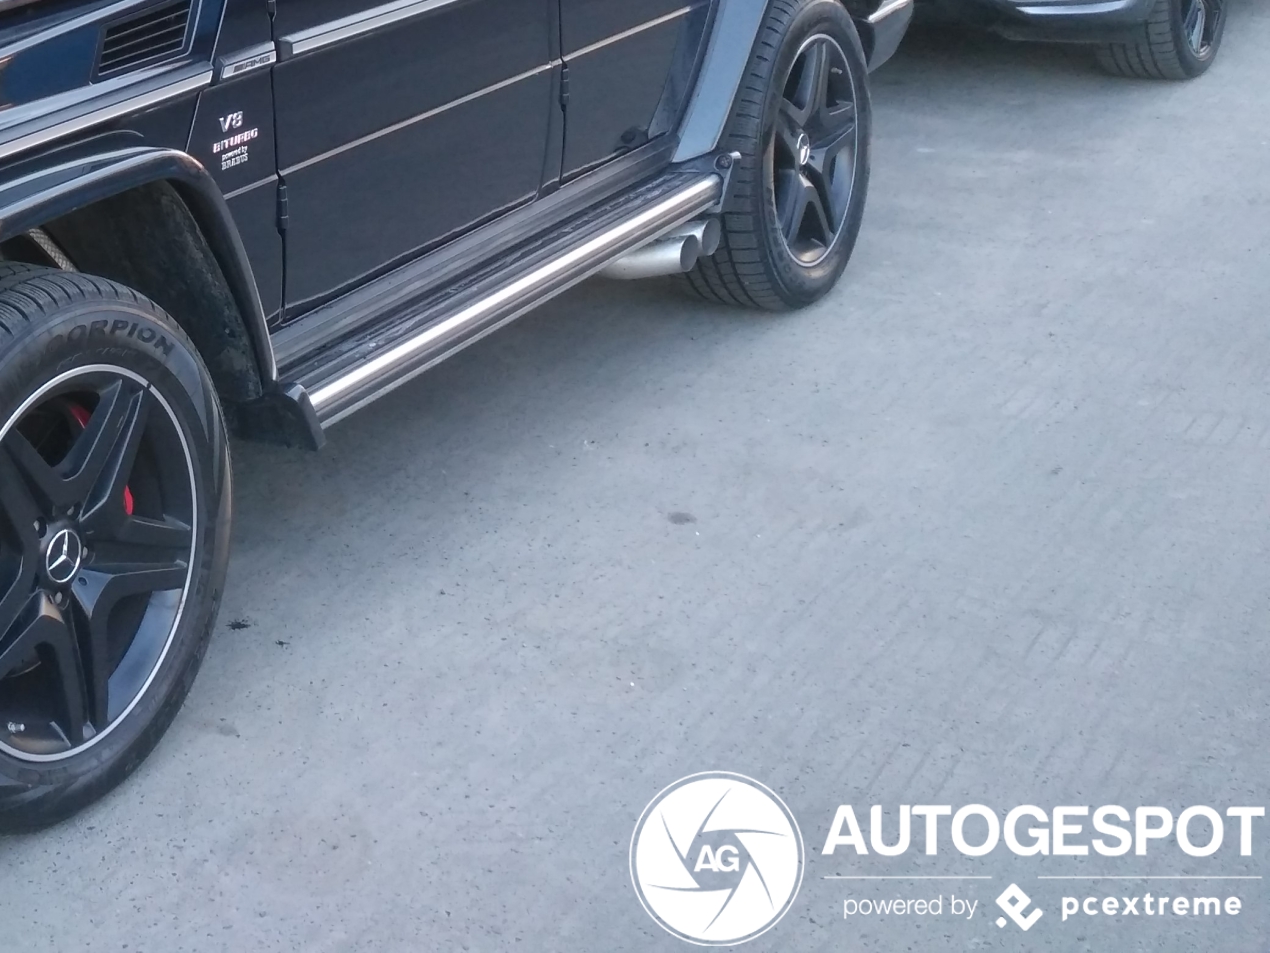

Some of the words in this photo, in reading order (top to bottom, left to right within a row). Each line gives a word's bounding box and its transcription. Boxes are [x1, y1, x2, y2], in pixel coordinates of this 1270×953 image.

[244, 55, 271, 69] AMG
[219, 111, 243, 132] V8
[213, 128, 258, 153] BITURBO
[221, 153, 248, 170] BRABUS
